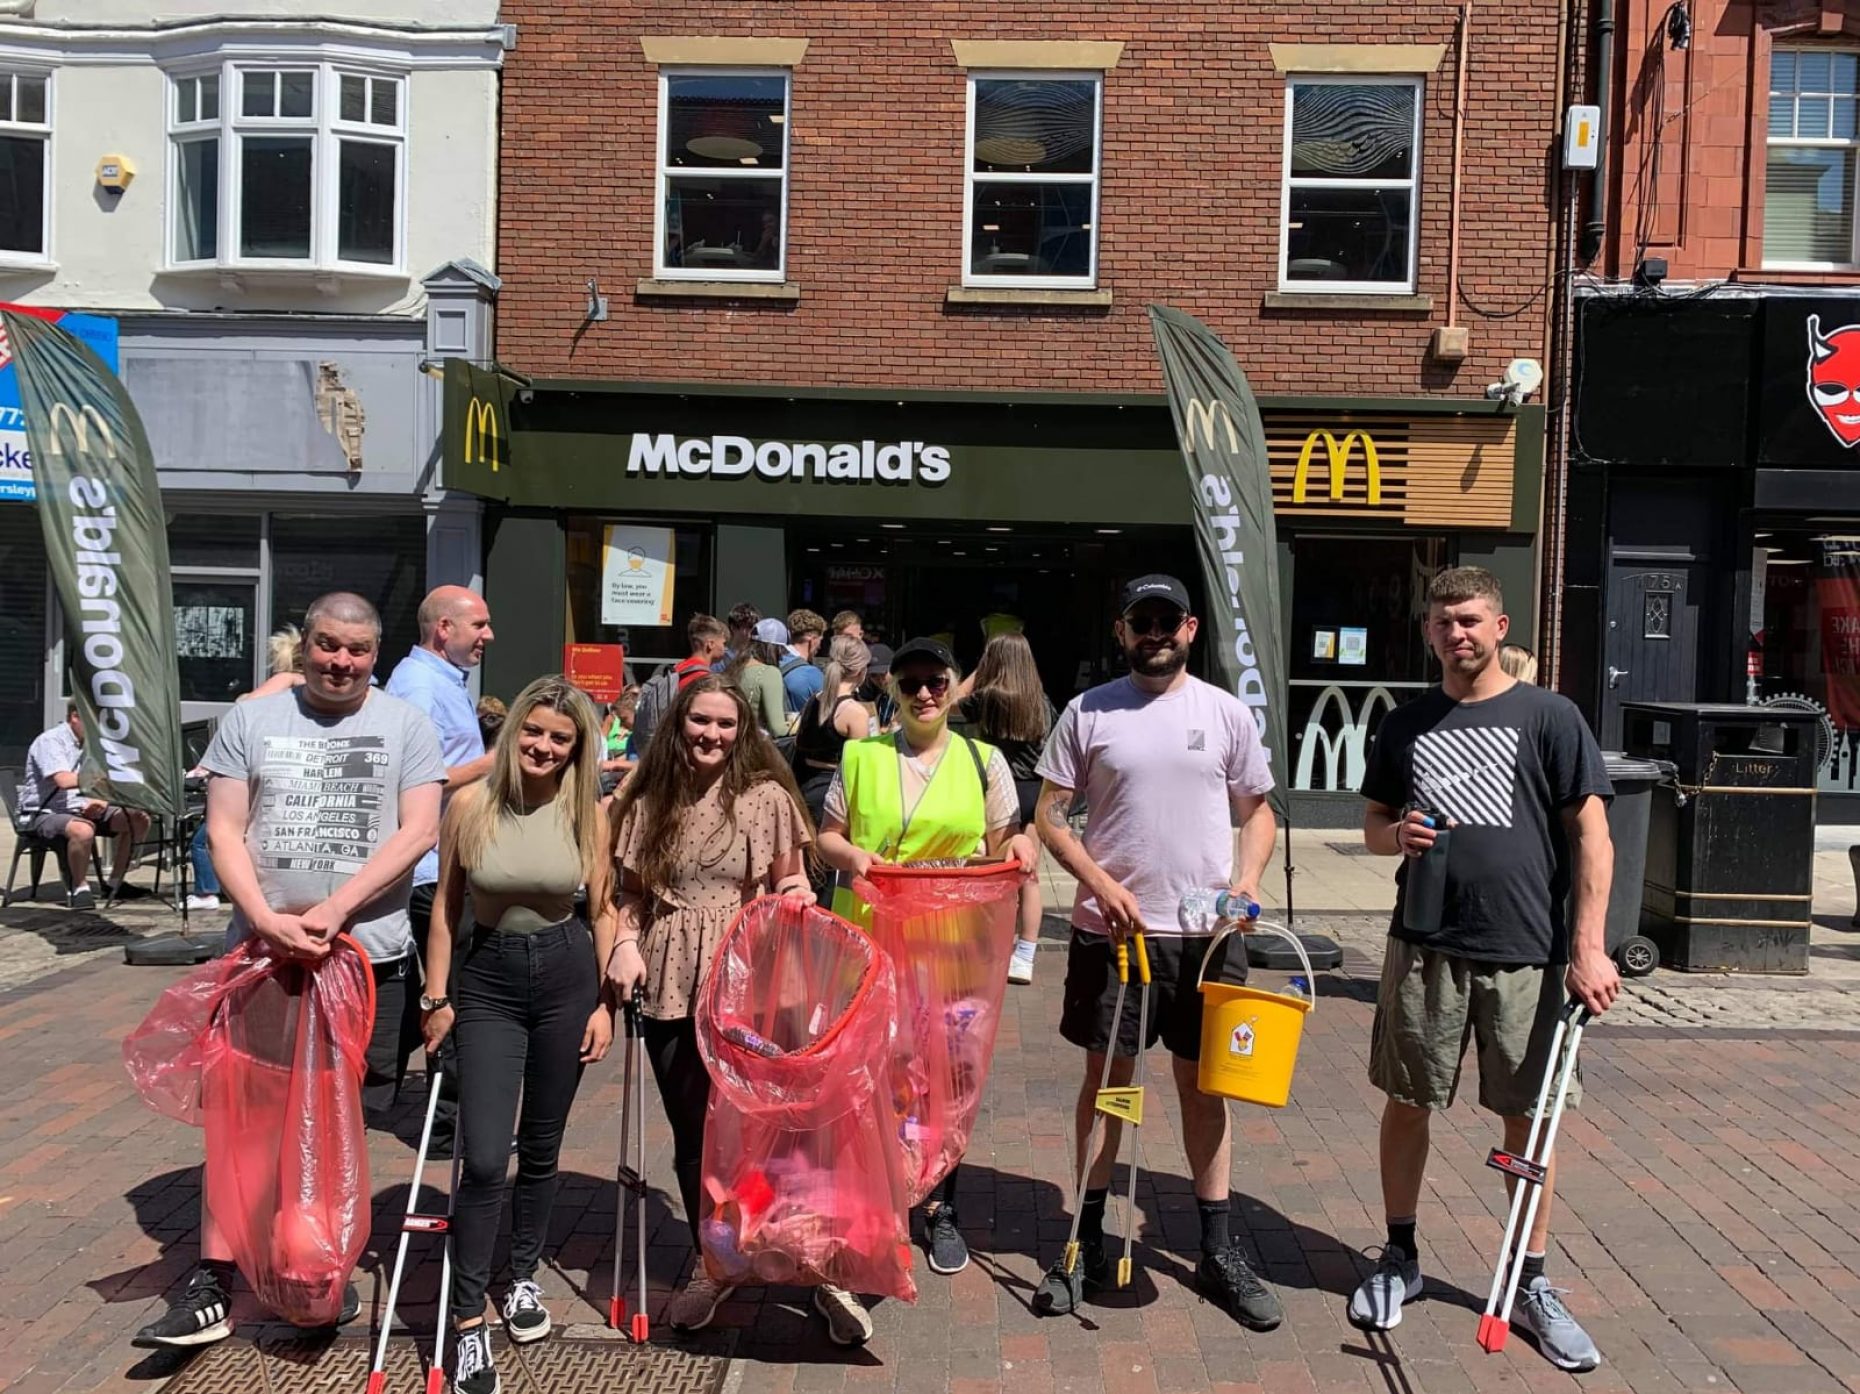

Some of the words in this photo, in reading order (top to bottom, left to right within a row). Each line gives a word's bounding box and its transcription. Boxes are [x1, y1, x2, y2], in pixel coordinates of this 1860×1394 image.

[626, 432, 952, 483] McDonald's
[299, 740, 318, 749] THE
[306, 753, 350, 764] DETROIT
[364, 752, 388, 764] 369
[303, 767, 343, 778] HARLEM
[322, 782, 359, 793] BEACH
[285, 795, 357, 808] CALIFORNIA
[283, 810, 304, 820] LOS
[307, 812, 356, 823] ANGELES
[275, 827, 294, 837] SAN
[297, 827, 360, 839] FRANCISCO
[341, 844, 359, 857] GA
